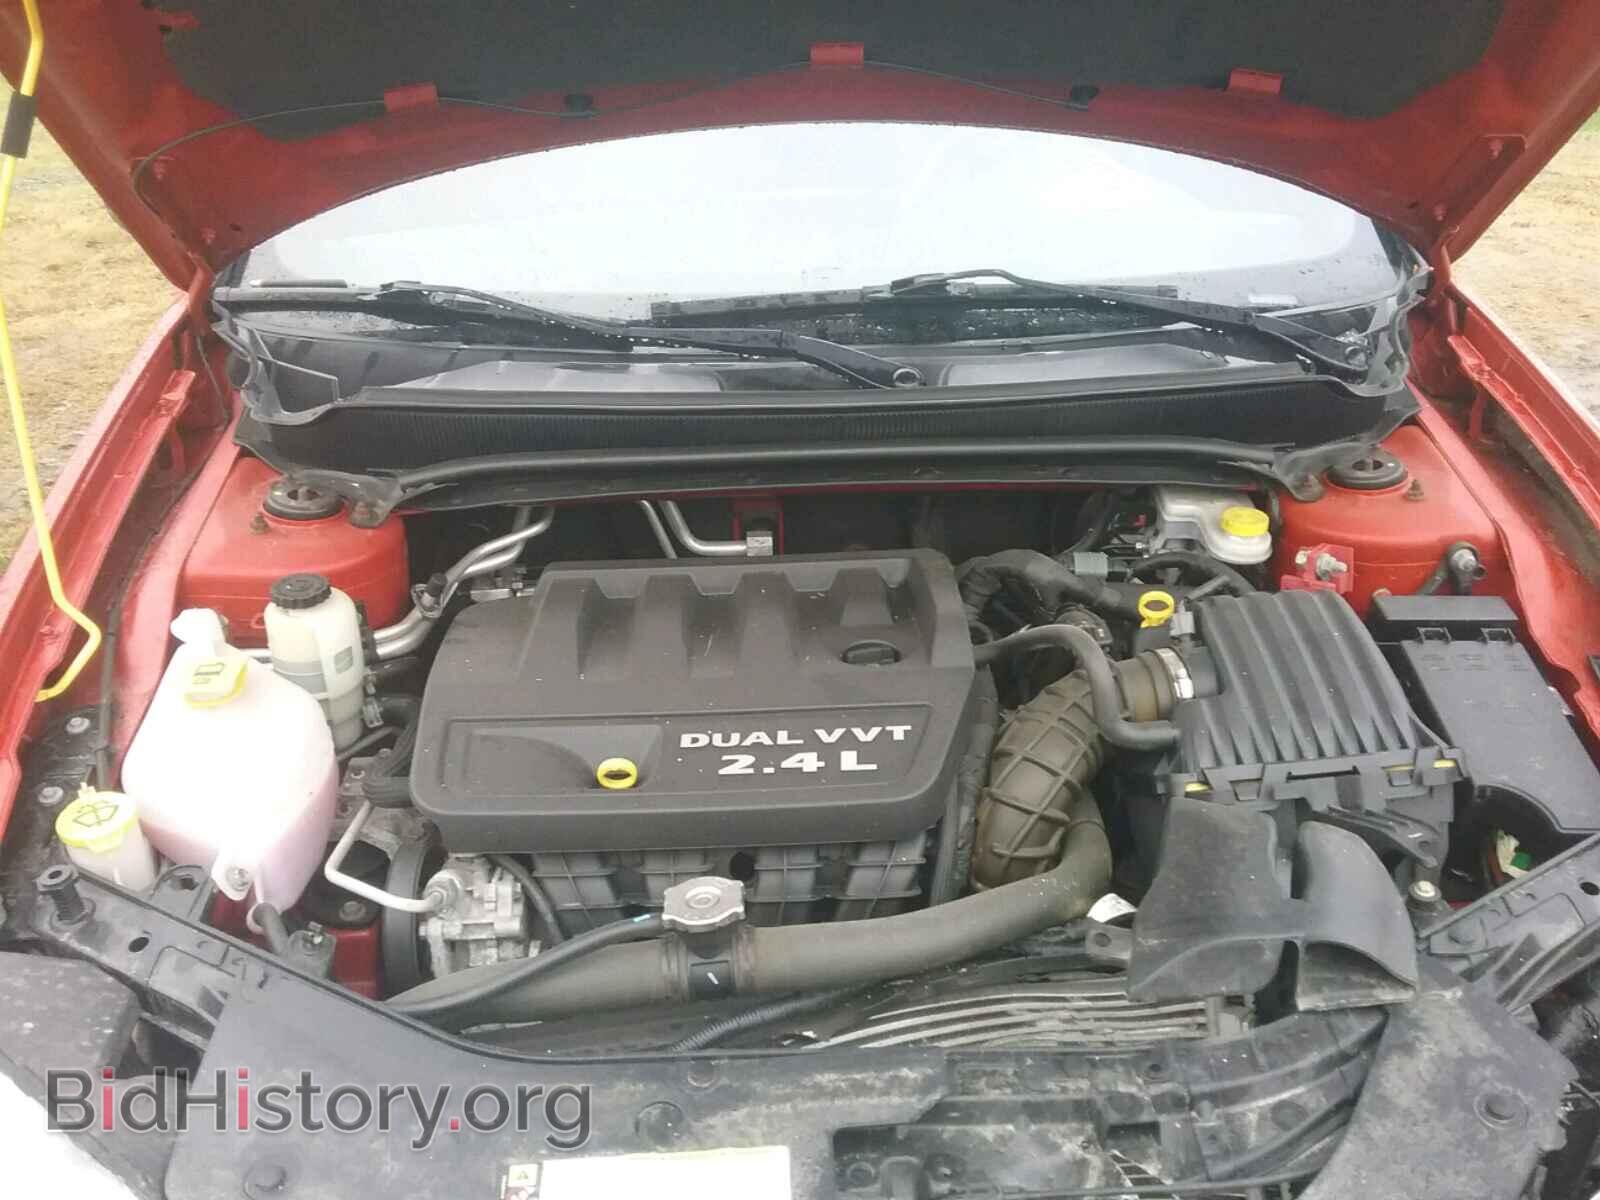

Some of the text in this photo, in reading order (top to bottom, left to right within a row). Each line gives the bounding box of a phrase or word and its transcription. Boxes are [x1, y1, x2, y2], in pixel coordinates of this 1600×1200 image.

[680, 725, 912, 748] DUAL VVT
[718, 752, 825, 775] 2.4
